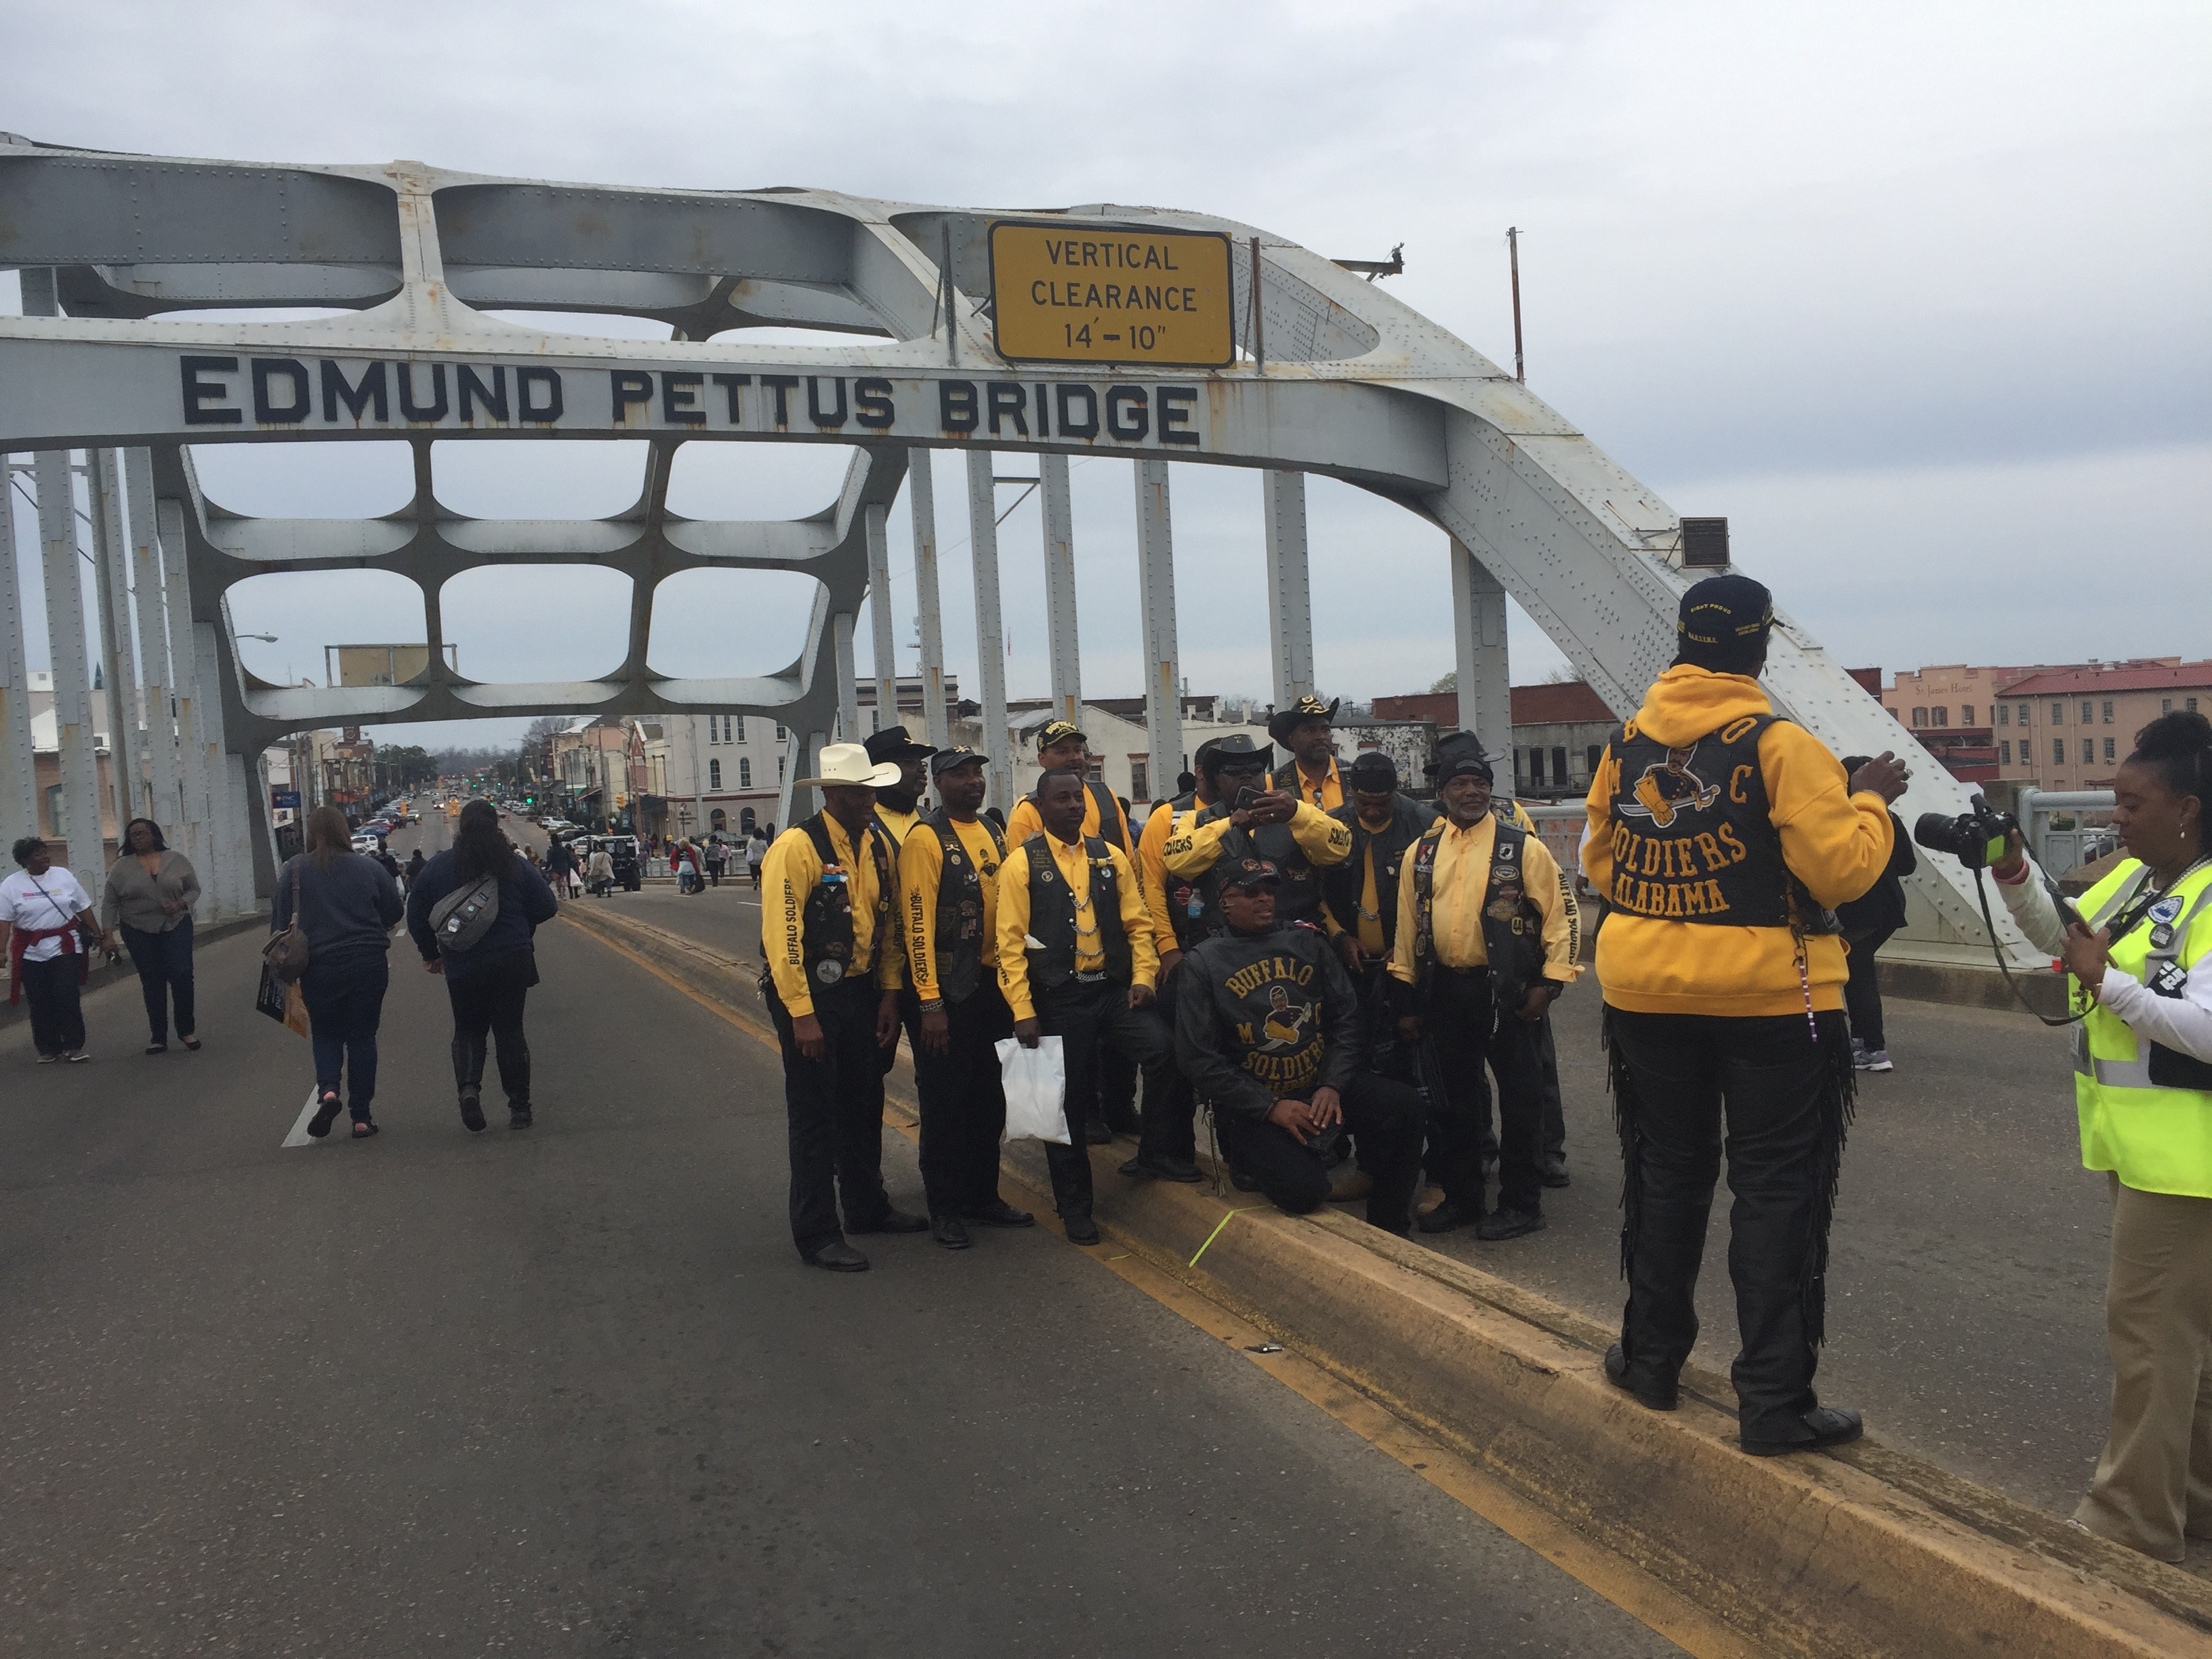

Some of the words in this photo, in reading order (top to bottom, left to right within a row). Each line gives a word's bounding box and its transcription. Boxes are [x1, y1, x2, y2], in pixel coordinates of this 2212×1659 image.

[1046, 240, 1179, 270] VERTICAL
[1031, 280, 1197, 312] CLEARANCE
[180, 355, 563, 424] EDMUND
[611, 369, 895, 429] PETTUS
[939, 380, 1200, 445] BRIDGE
[1927, 684, 1948, 697] James
[1951, 682, 1972, 693] Hotel
[1729, 764, 1754, 804] C
[1614, 872, 1731, 916] ALABAMA
[910, 895, 925, 934] BUFFALO
[786, 924, 800, 966] BUFFALO
[912, 935, 928, 980] SOLDIERS
[1225, 956, 1314, 1000] BUFFALO
[1236, 1022, 1256, 1044] M
